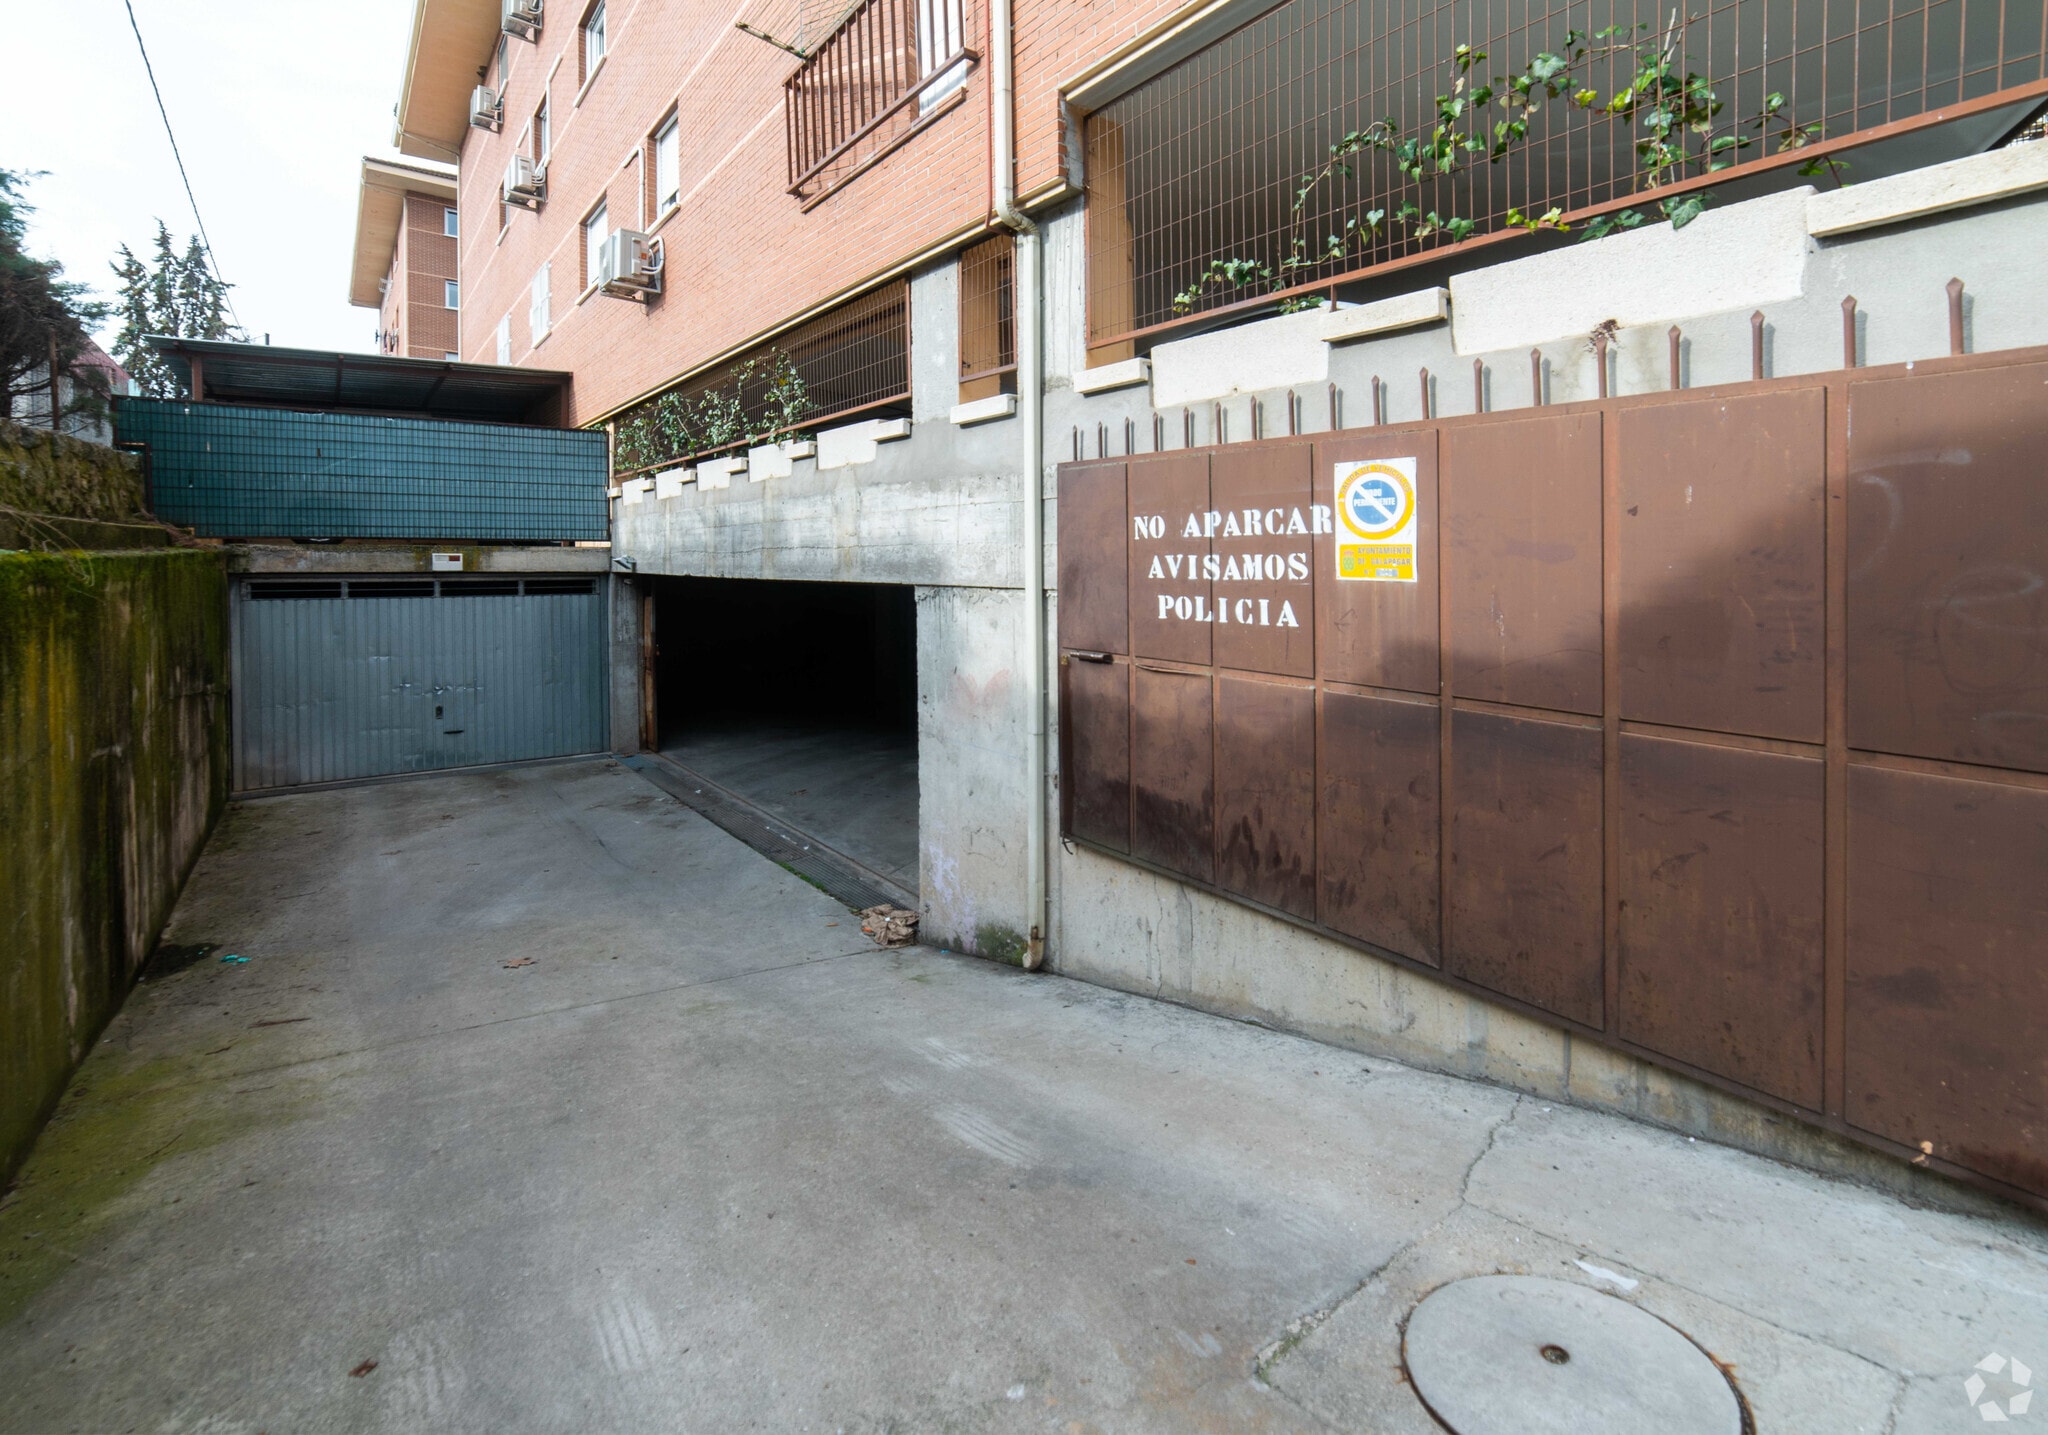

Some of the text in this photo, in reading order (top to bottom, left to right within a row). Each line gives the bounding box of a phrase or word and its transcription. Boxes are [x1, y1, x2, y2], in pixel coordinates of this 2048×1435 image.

[1364, 488, 1382, 497] ADO
[1353, 497, 1396, 506] PERMENTE
[1133, 505, 1332, 540] NO APARCAR
[1357, 547, 1411, 555] AYUNTAMIENTO
[1148, 552, 1309, 581] AVISAMOS
[1371, 558, 1411, 566] GALAPAGAR
[1157, 595, 1300, 627] POLICIA
